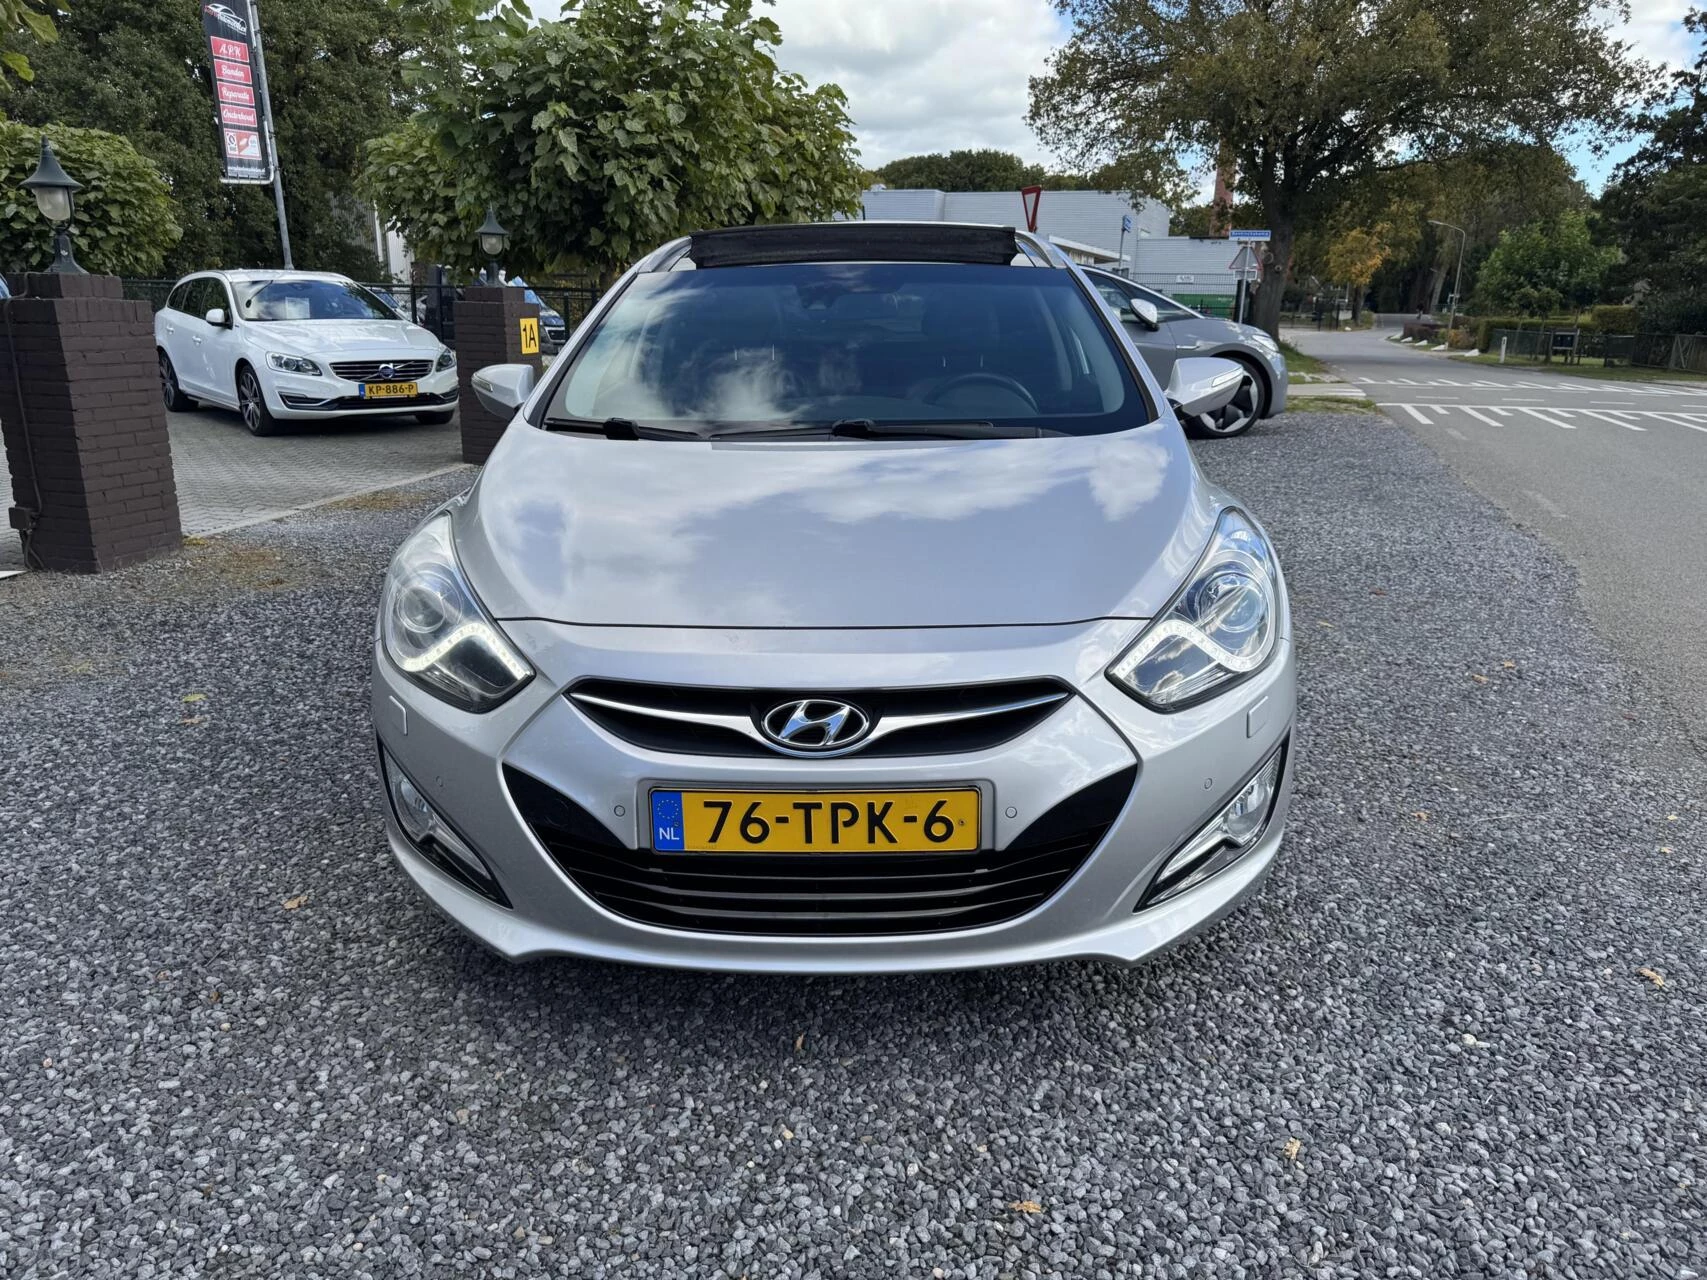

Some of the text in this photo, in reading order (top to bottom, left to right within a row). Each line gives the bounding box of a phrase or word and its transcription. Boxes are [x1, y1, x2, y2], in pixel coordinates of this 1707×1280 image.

[223, 109, 255, 121] Onderhoud
[522, 323, 537, 348] 1A
[368, 384, 414, 394] KP-886-P
[659, 800, 954, 844] NL 76-TPK-6
